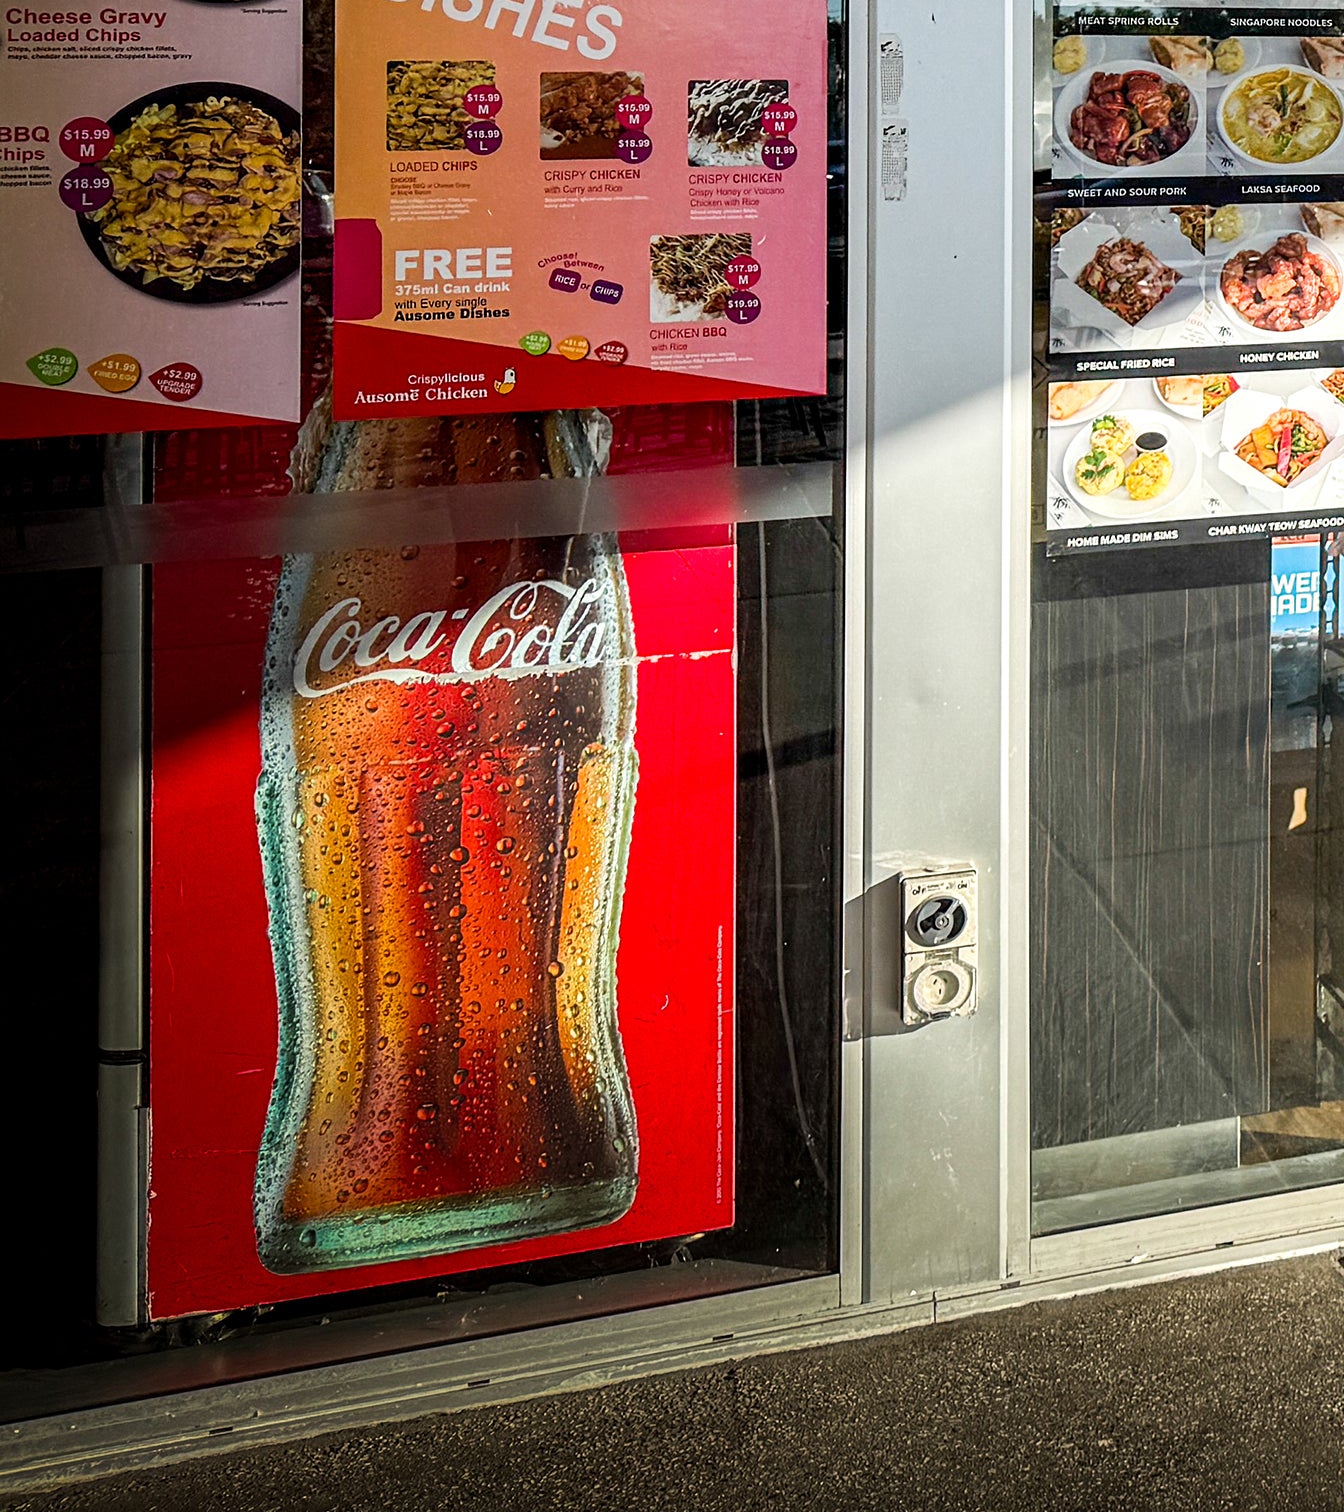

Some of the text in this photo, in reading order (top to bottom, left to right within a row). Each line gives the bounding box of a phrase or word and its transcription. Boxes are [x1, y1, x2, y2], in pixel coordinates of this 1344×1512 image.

[6, 8, 167, 28] Cheese Gravy
[1078, 17, 1180, 26] MEAT SPRING ROLLS
[1230, 18, 1333, 27] SINGAPORE NOODLES
[7, 28, 141, 45] Loaded Chips
[0, 126, 50, 143] BBQ
[64, 129, 110, 141] $15.99
[390, 161, 478, 173] LOADED CHIPS
[544, 169, 641, 181] CRISPY CHICKEN
[688, 173, 782, 185] CRISPY CHICKEN
[64, 178, 110, 190] $18.99
[1241, 184, 1320, 194] LAKSA SEAFOOD
[1067, 187, 1187, 197] SWEET AND SOUR PORK
[394, 247, 513, 282] FREE
[537, 251, 578, 269] Choose!
[563, 259, 605, 272] Between
[555, 274, 576, 286] RICE
[395, 282, 510, 296] 375ml Can drink
[594, 285, 619, 298] CHIPS
[394, 307, 510, 322] Ausome Dishes
[650, 327, 727, 340] CHICKEN BBQ
[1240, 350, 1319, 364] HONEY CHICKEN
[1077, 358, 1175, 371] SPECIAL FRIED RICE
[408, 372, 485, 386] Crispylicious
[425, 387, 488, 401] Chicken
[1208, 516, 1344, 536] CHAR KWAY TEOW SEAFOOD
[1067, 530, 1179, 548] HOME MADE DIM SIMS
[293, 577, 608, 699] Coca-Cola
